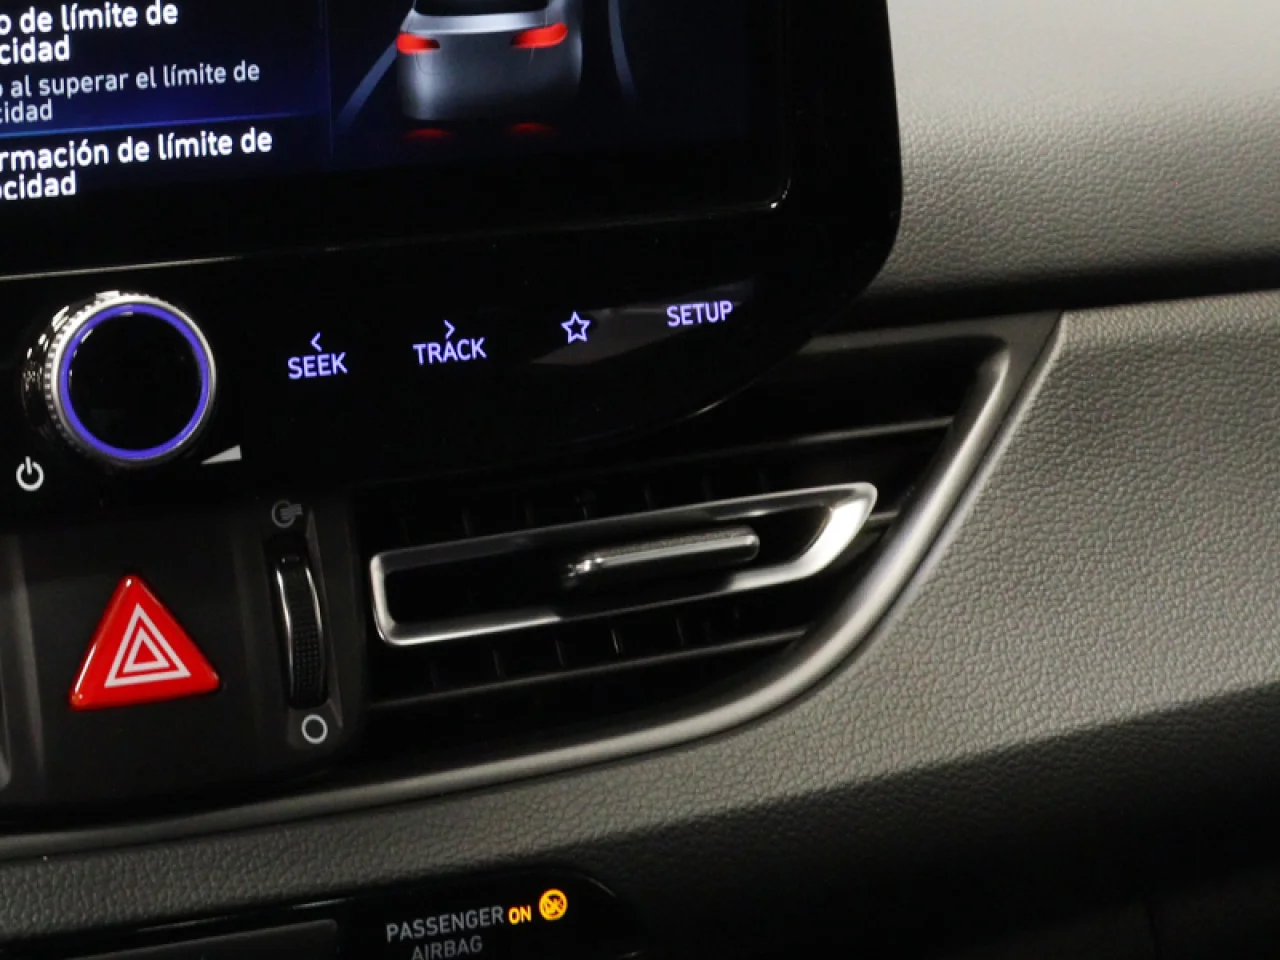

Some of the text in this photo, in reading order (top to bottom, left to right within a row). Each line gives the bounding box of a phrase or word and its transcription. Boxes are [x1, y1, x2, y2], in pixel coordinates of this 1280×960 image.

[20, 7, 52, 34] de
[61, 3, 137, 31] límite
[146, 0, 178, 25] de
[11, 75, 32, 97] al
[39, 73, 128, 99] superar
[136, 68, 157, 88] el
[163, 63, 226, 87] límite
[233, 61, 259, 81] de
[118, 137, 150, 162] de
[159, 133, 232, 159] límite
[241, 127, 272, 153] de
[666, 300, 733, 328] SETUP
[287, 352, 348, 379] SEEK
[413, 338, 487, 365] TRACK
[386, 905, 532, 942] PASSENGER ON
[411, 936, 483, 960] AIRBAG
